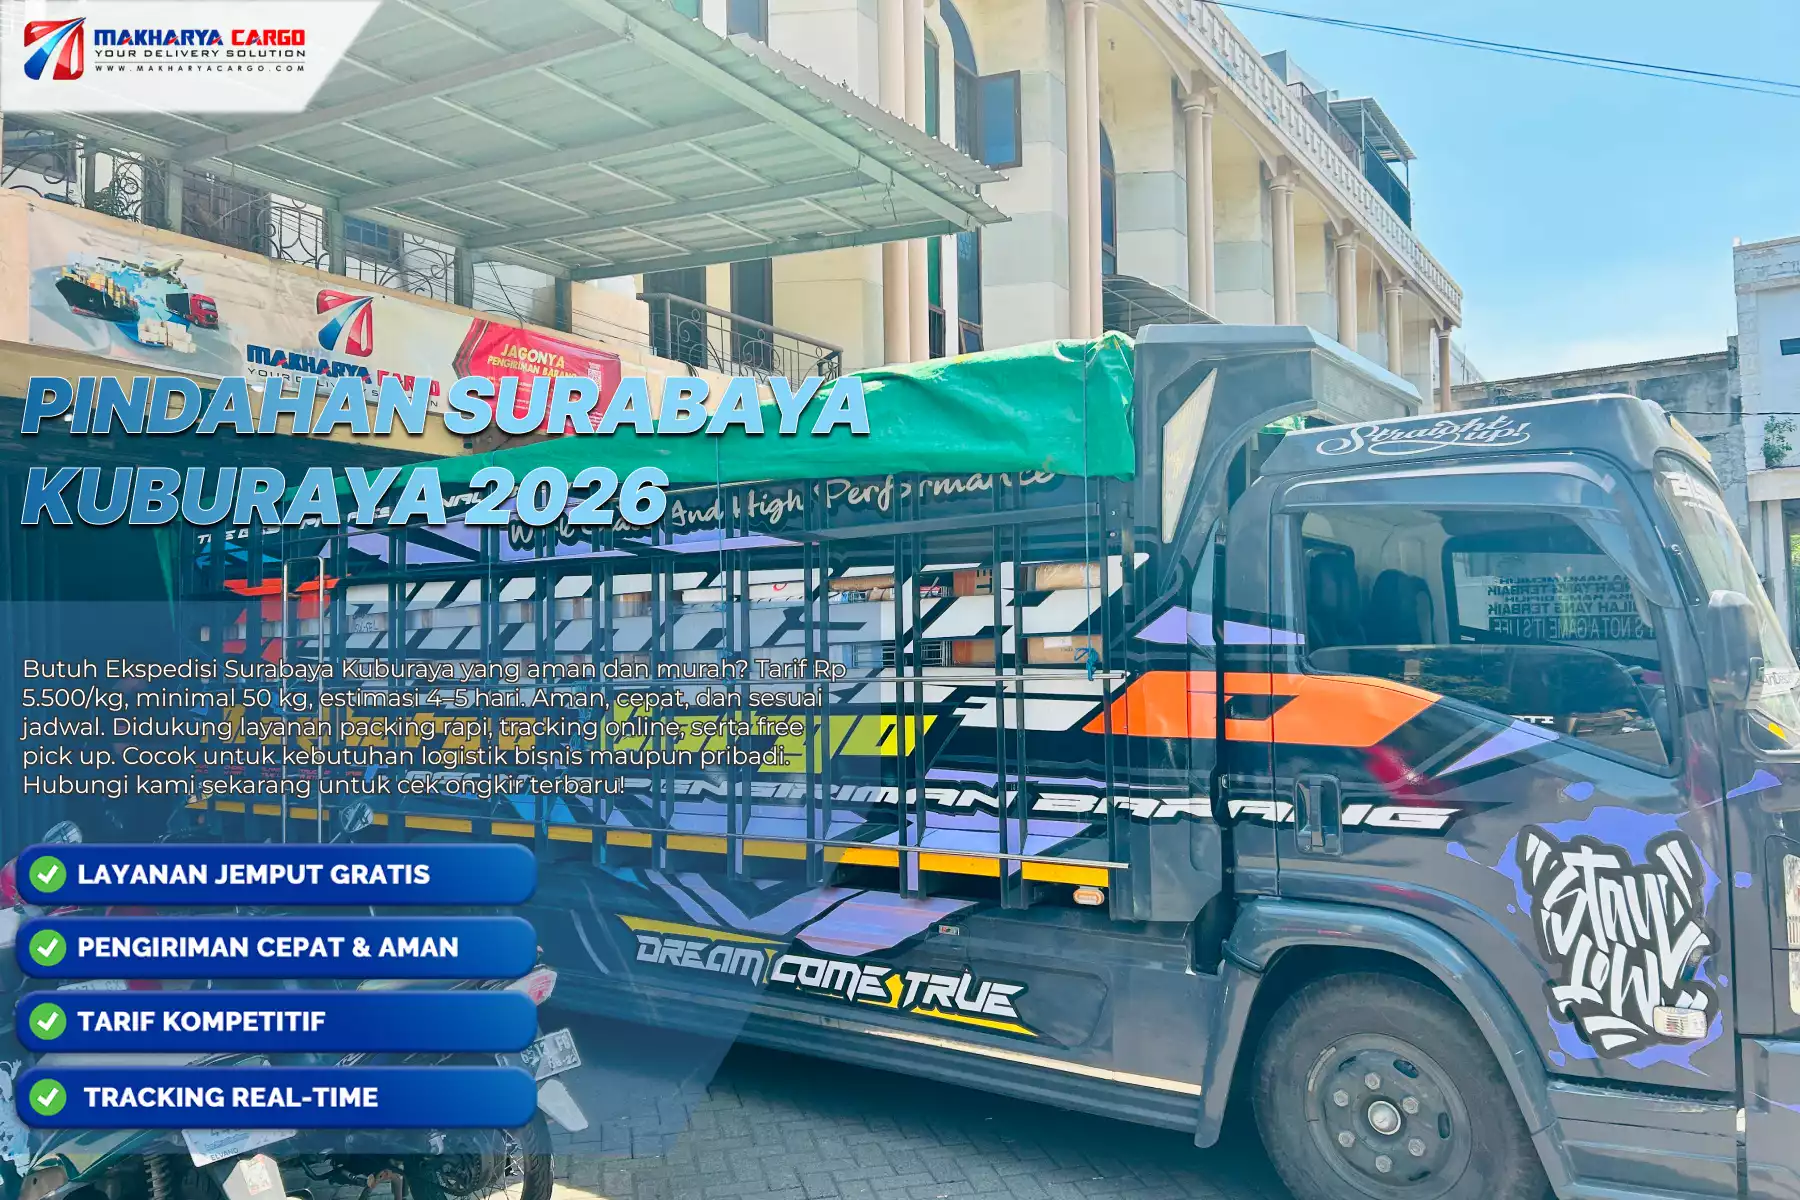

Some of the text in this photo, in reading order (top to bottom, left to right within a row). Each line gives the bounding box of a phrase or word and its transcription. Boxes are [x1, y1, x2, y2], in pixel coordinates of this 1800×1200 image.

[246, 344, 373, 384] MAKHARYA
[487, 355, 540, 376] PENGIRIMAN
[500, 343, 565, 369] JAGONYA
[1316, 415, 1515, 456] Straight
[635, 933, 1025, 1018] DREAM COME TRUE
